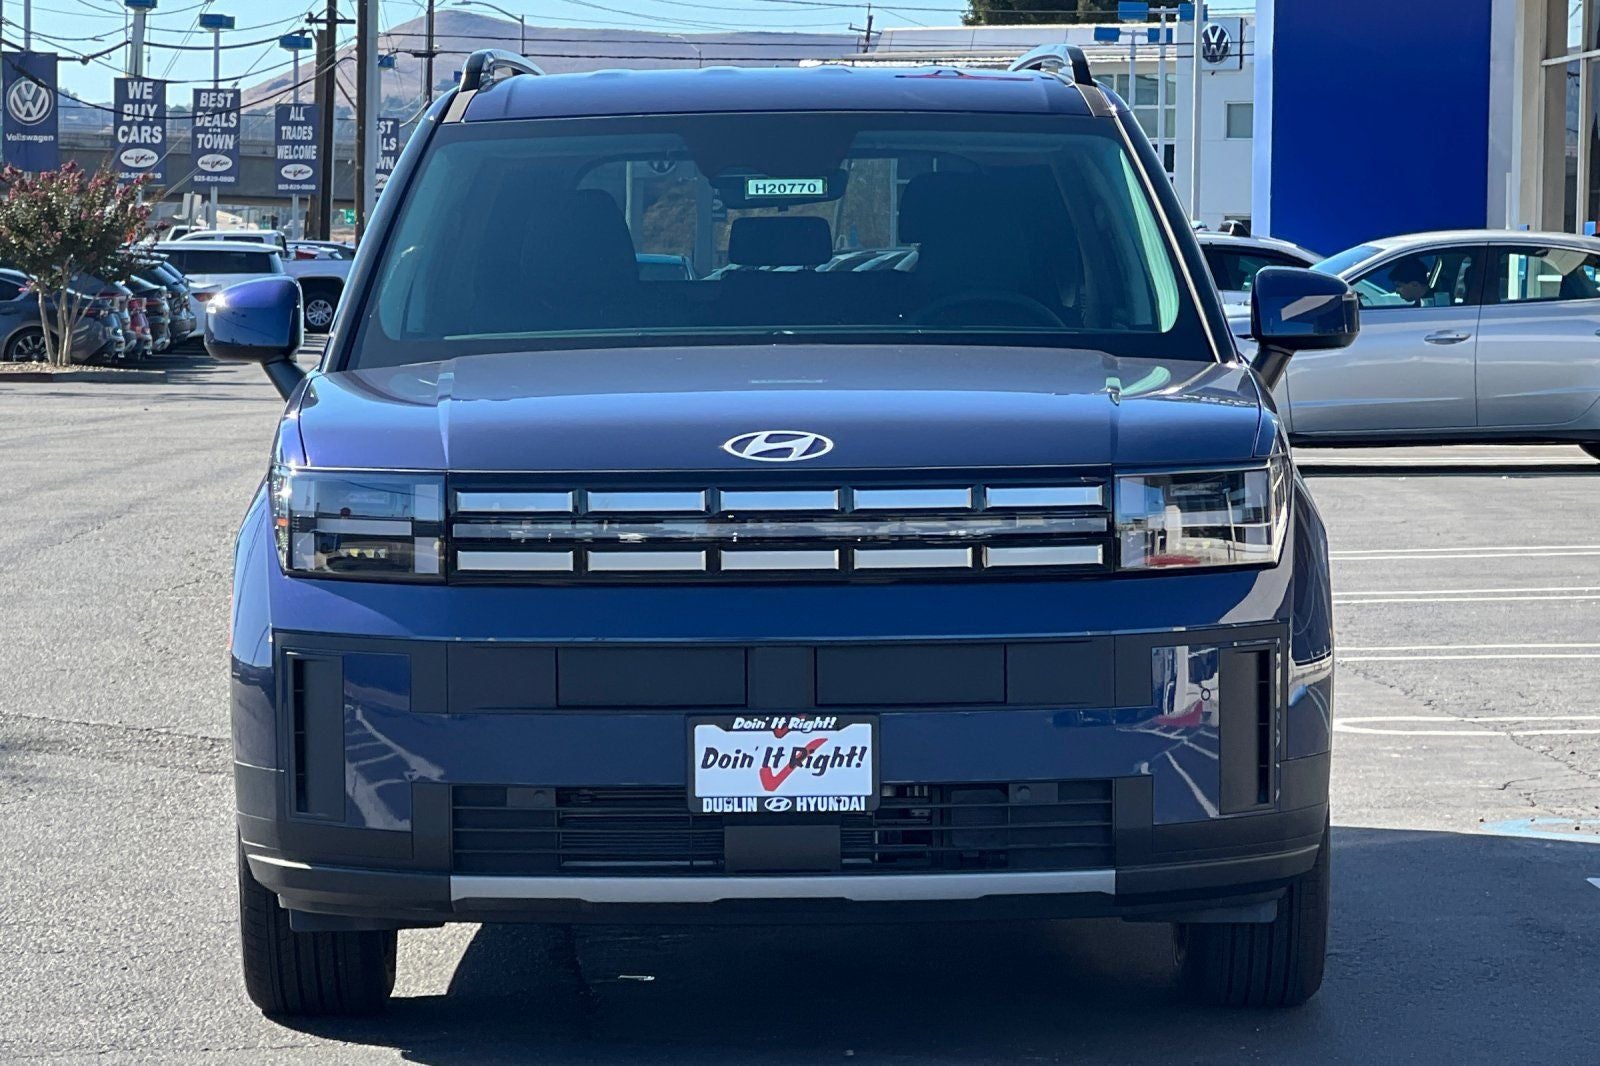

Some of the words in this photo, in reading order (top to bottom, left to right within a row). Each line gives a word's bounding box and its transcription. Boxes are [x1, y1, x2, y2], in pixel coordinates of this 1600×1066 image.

[128, 82, 153, 99] WE
[200, 92, 234, 108] BEST
[123, 104, 158, 121] BUY
[195, 112, 237, 128] DEALS
[289, 106, 305, 121] ALL
[117, 126, 162, 144] CARS
[281, 126, 313, 140] TRADES
[197, 134, 235, 149] TOWN
[277, 145, 317, 160] WELCOME
[755, 183, 817, 194] H20770
[732, 717, 769, 730] Doin'
[770, 717, 786, 729] It
[788, 716, 837, 733] Right!
[700, 746, 758, 769] Doin'
[762, 746, 785, 768] It
[789, 746, 868, 777] Right!
[702, 797, 758, 812] DUBLIN
[796, 797, 866, 811] HYUNDAI
